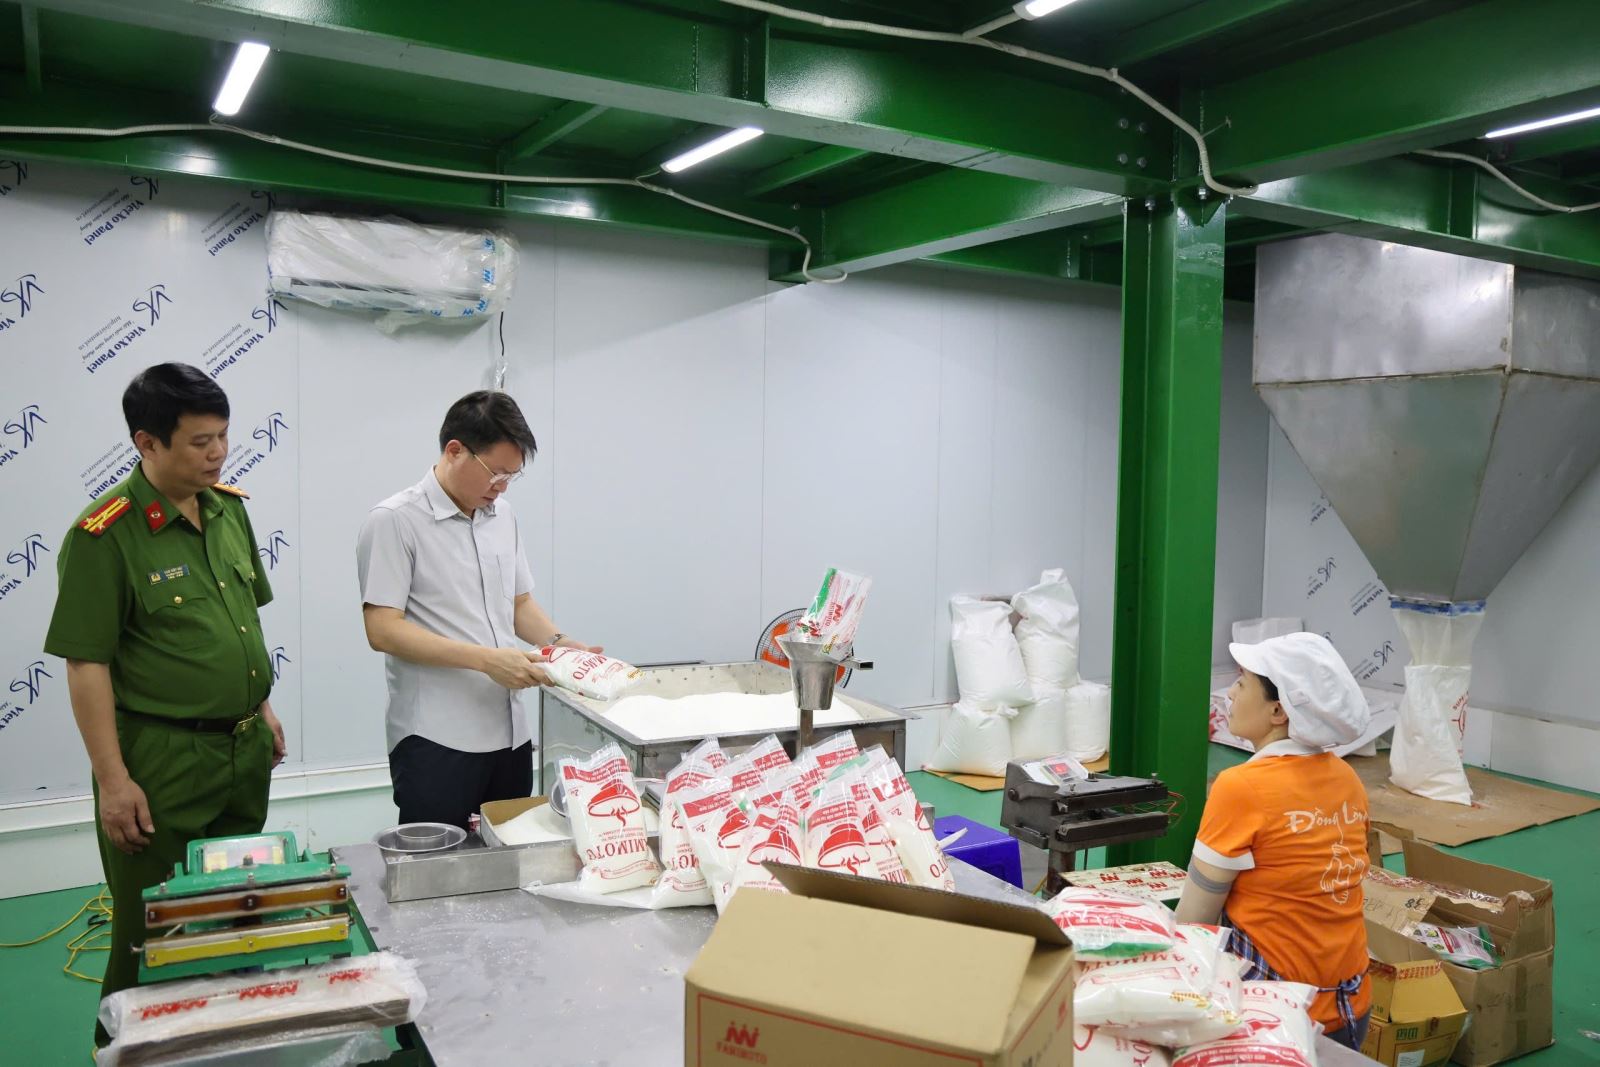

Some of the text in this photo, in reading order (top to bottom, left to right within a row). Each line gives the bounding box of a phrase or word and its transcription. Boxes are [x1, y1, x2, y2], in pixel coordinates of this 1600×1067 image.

[0, 318, 16, 331] Vie
[87, 327, 146, 373] VietXo Panel
[210, 334, 263, 378] VietXo Panel
[0, 449, 18, 466] Viet
[116, 455, 142, 475] ietXo
[236, 454, 264, 476] VietXo
[0, 579, 22, 600] Viet
[0, 706, 24, 731] Viet
